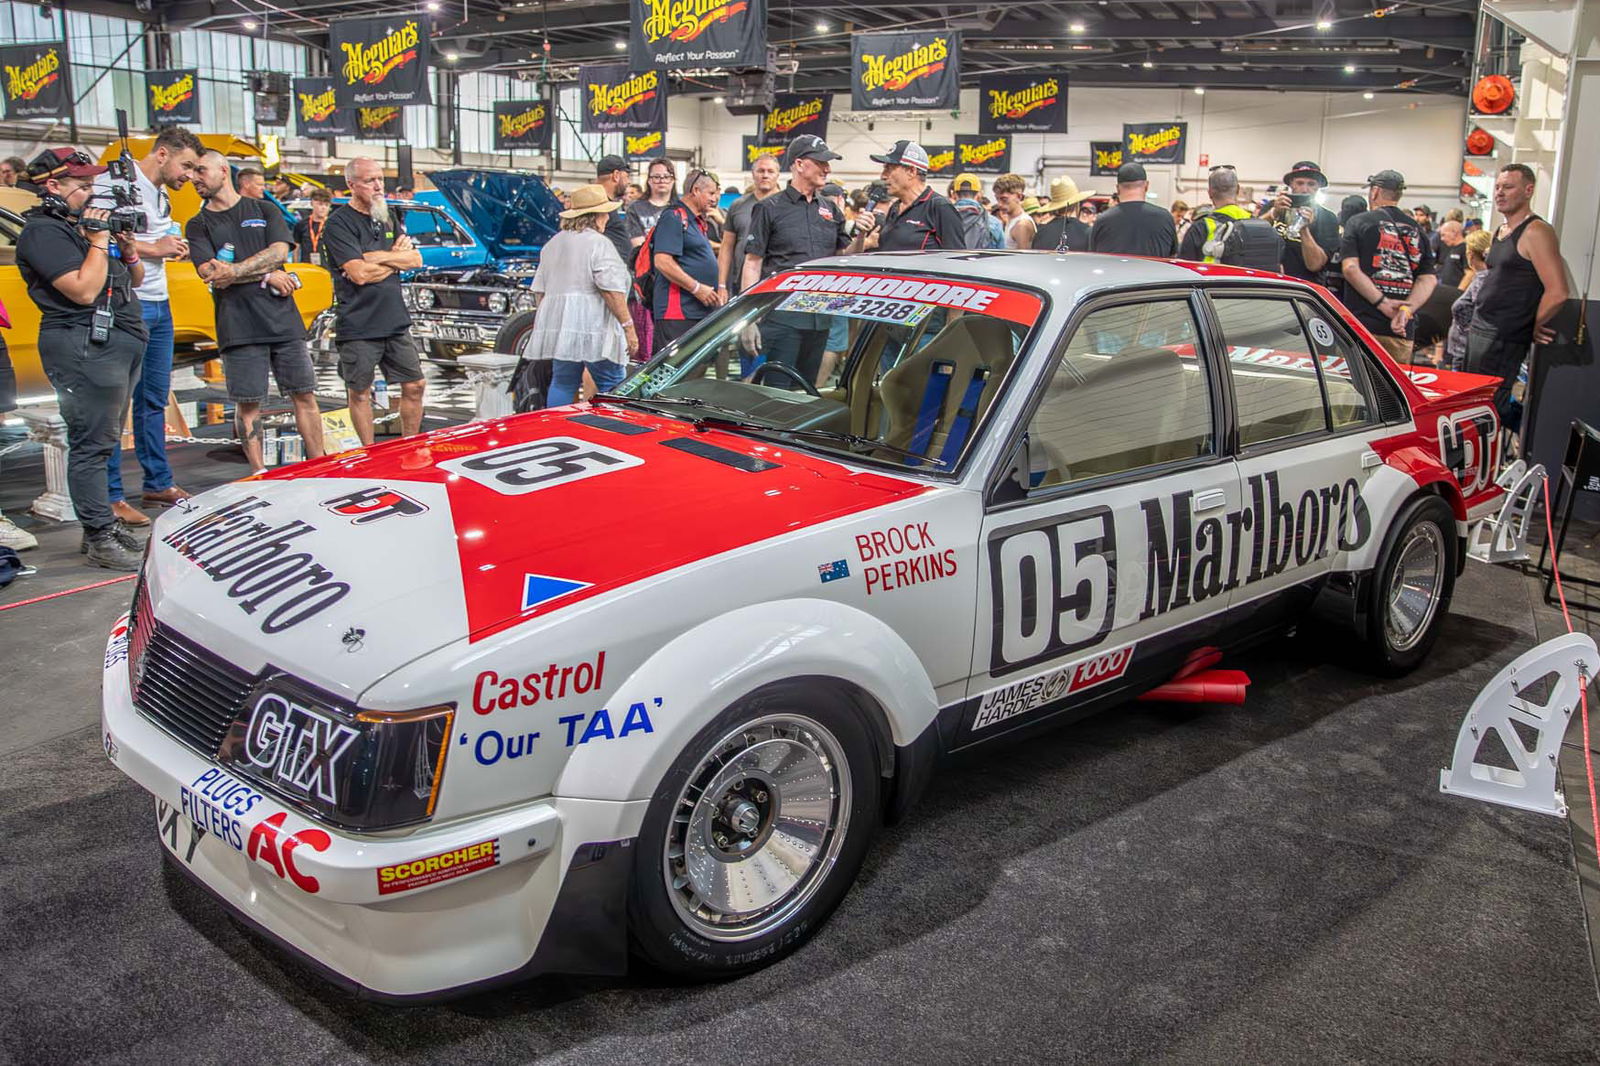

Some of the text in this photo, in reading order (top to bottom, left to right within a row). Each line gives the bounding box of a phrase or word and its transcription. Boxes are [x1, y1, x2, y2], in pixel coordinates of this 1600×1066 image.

[341, 20, 419, 85] Meguiar's
[655, 52, 684, 63] Reflect
[687, 52, 704, 60] Your
[862, 37, 947, 91] Meguiar's
[588, 69, 658, 116] Meguiar's
[988, 78, 1059, 118] Meguiar's
[776, 275, 1000, 311] COMMODORE
[850, 299, 916, 320] 3288
[461, 441, 625, 487] 05
[162, 495, 350, 634] Marlboro
[855, 521, 936, 562] BROCK
[1139, 471, 1371, 621] Marlboro
[863, 548, 958, 596] PERKINS
[1000, 516, 1109, 664] 05
[472, 650, 606, 715] Castrol
[984, 650, 1126, 710] JAMES 1000
[976, 692, 1040, 728] HARDIE
[245, 692, 361, 806] GTX
[192, 767, 264, 816] PLUGS
[180, 785, 243, 852] FILTERS
[247, 811, 332, 894] AC
[380, 841, 494, 882] SCORCHER
